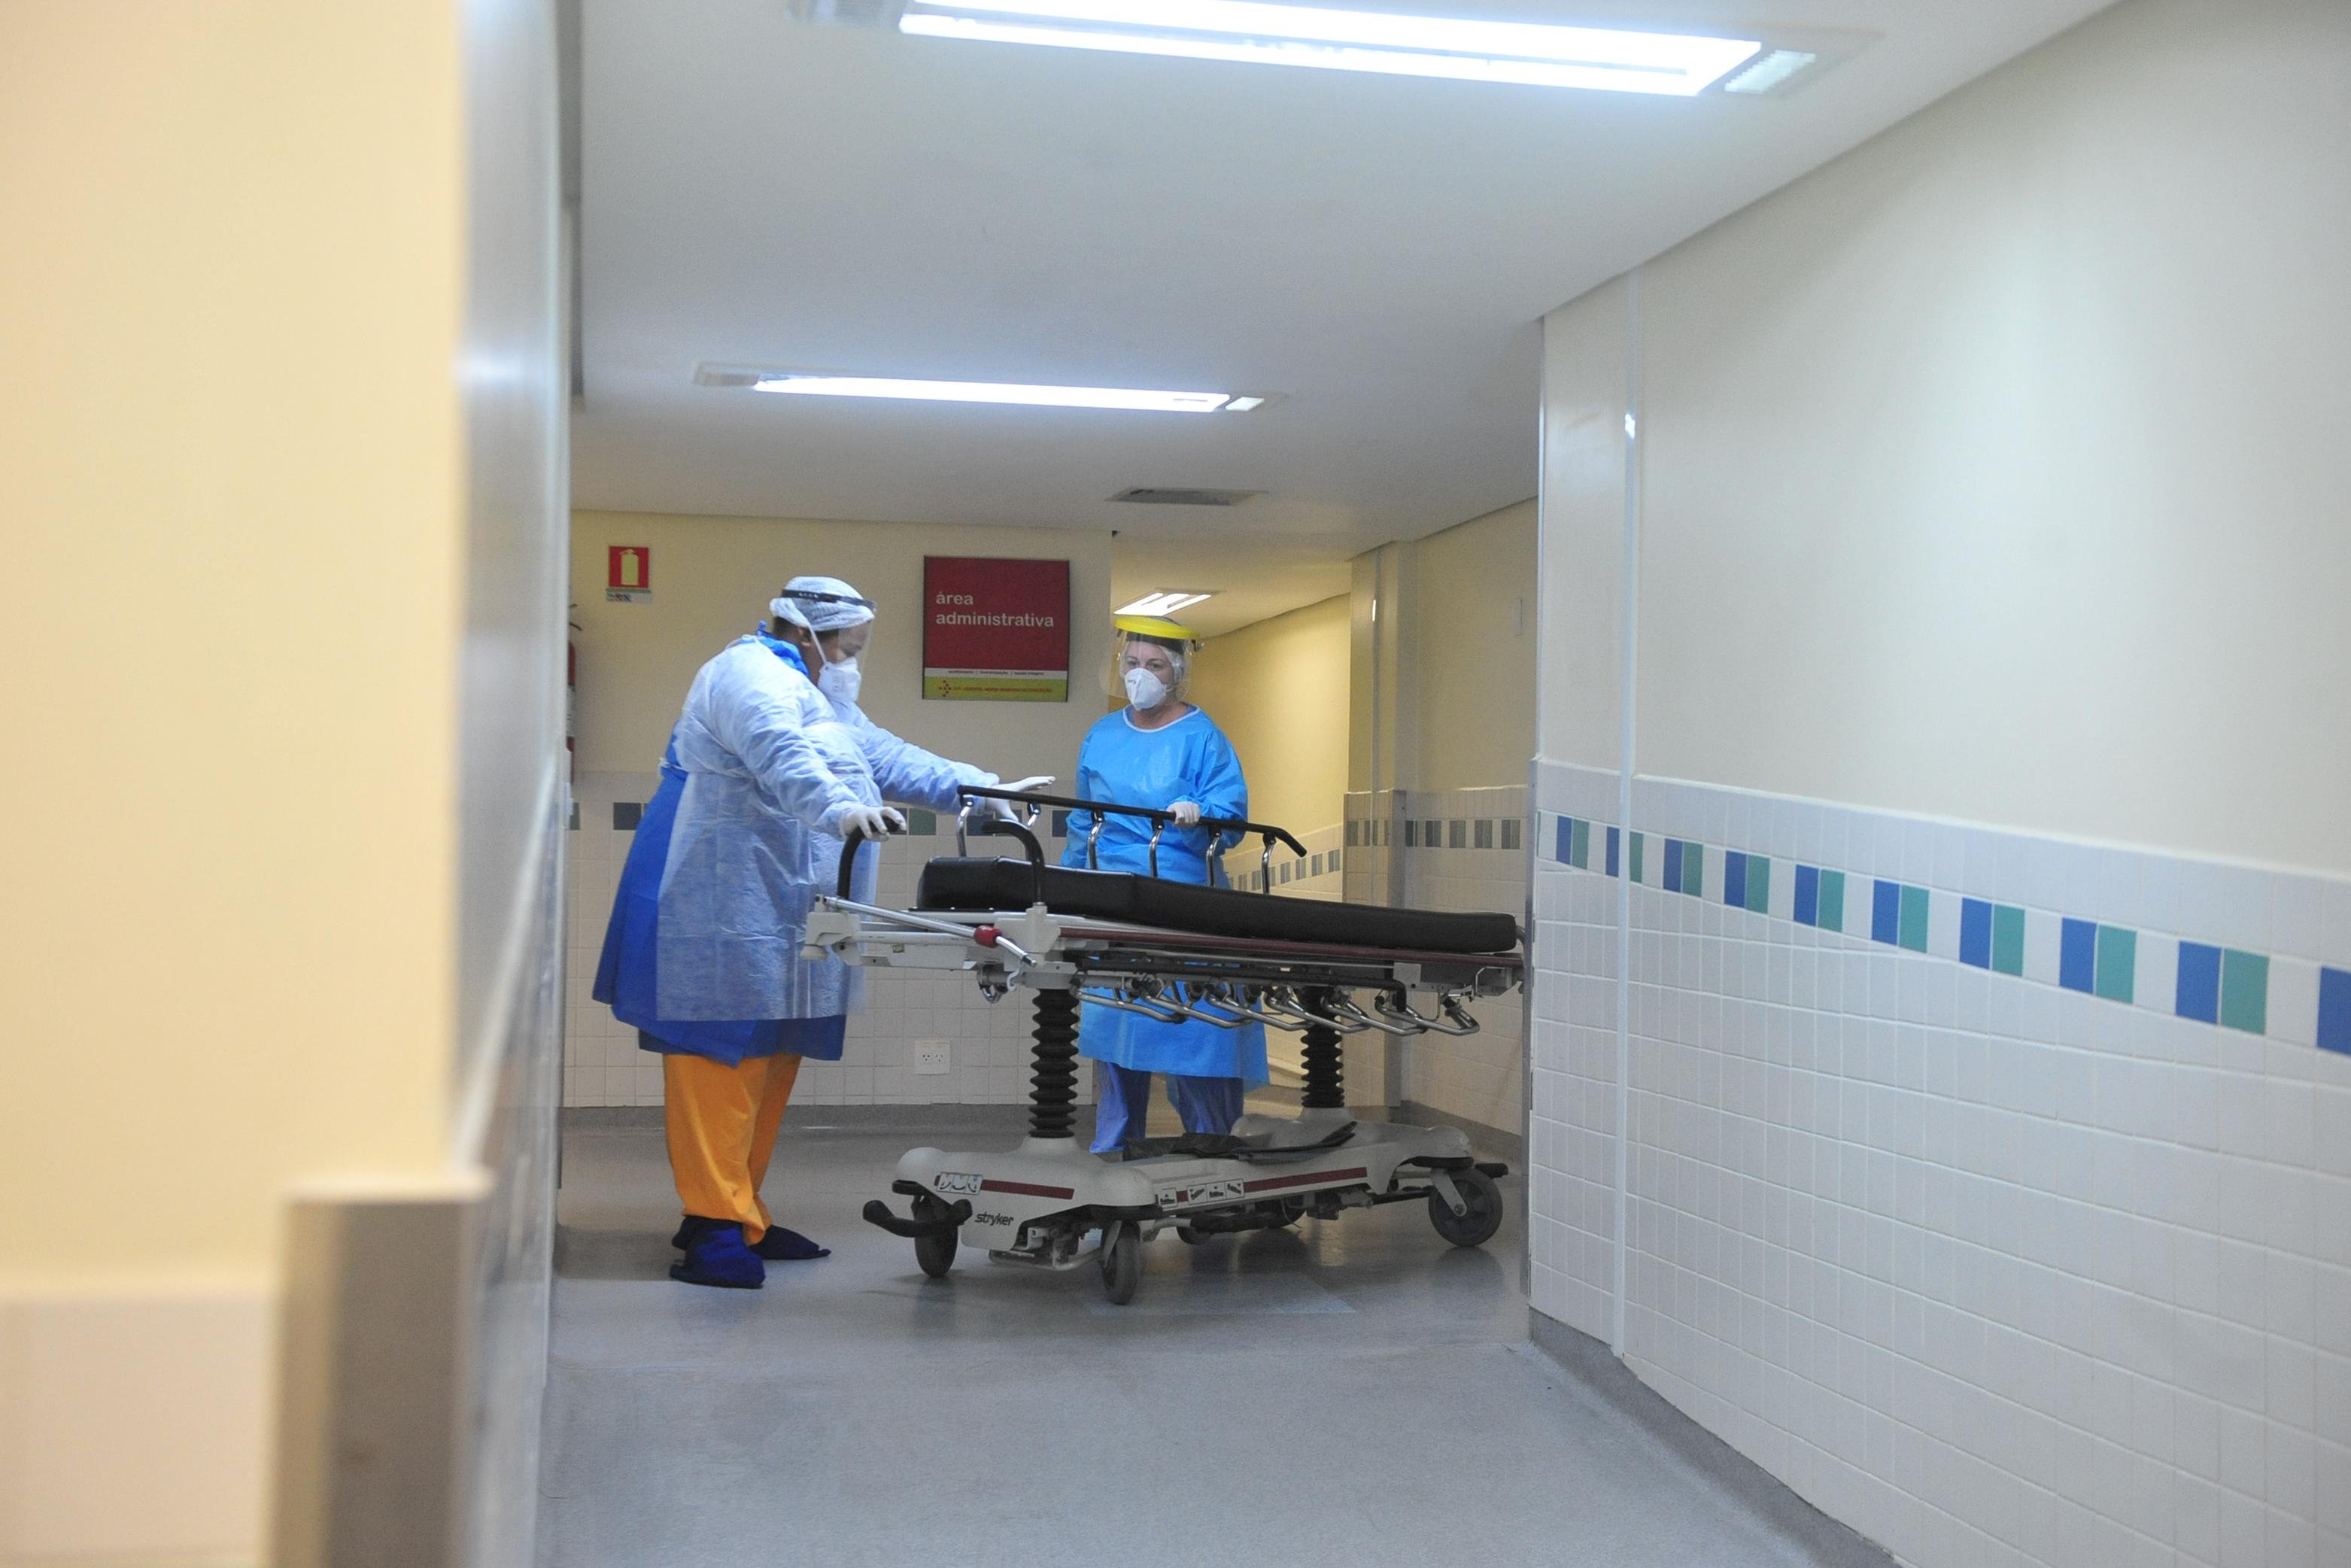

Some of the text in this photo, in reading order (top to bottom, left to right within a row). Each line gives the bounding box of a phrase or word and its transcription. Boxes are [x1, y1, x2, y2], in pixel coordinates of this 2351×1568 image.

[936, 591, 974, 606] área
[936, 612, 1054, 628] administrativa
[974, 1211, 1014, 1226] stryker
